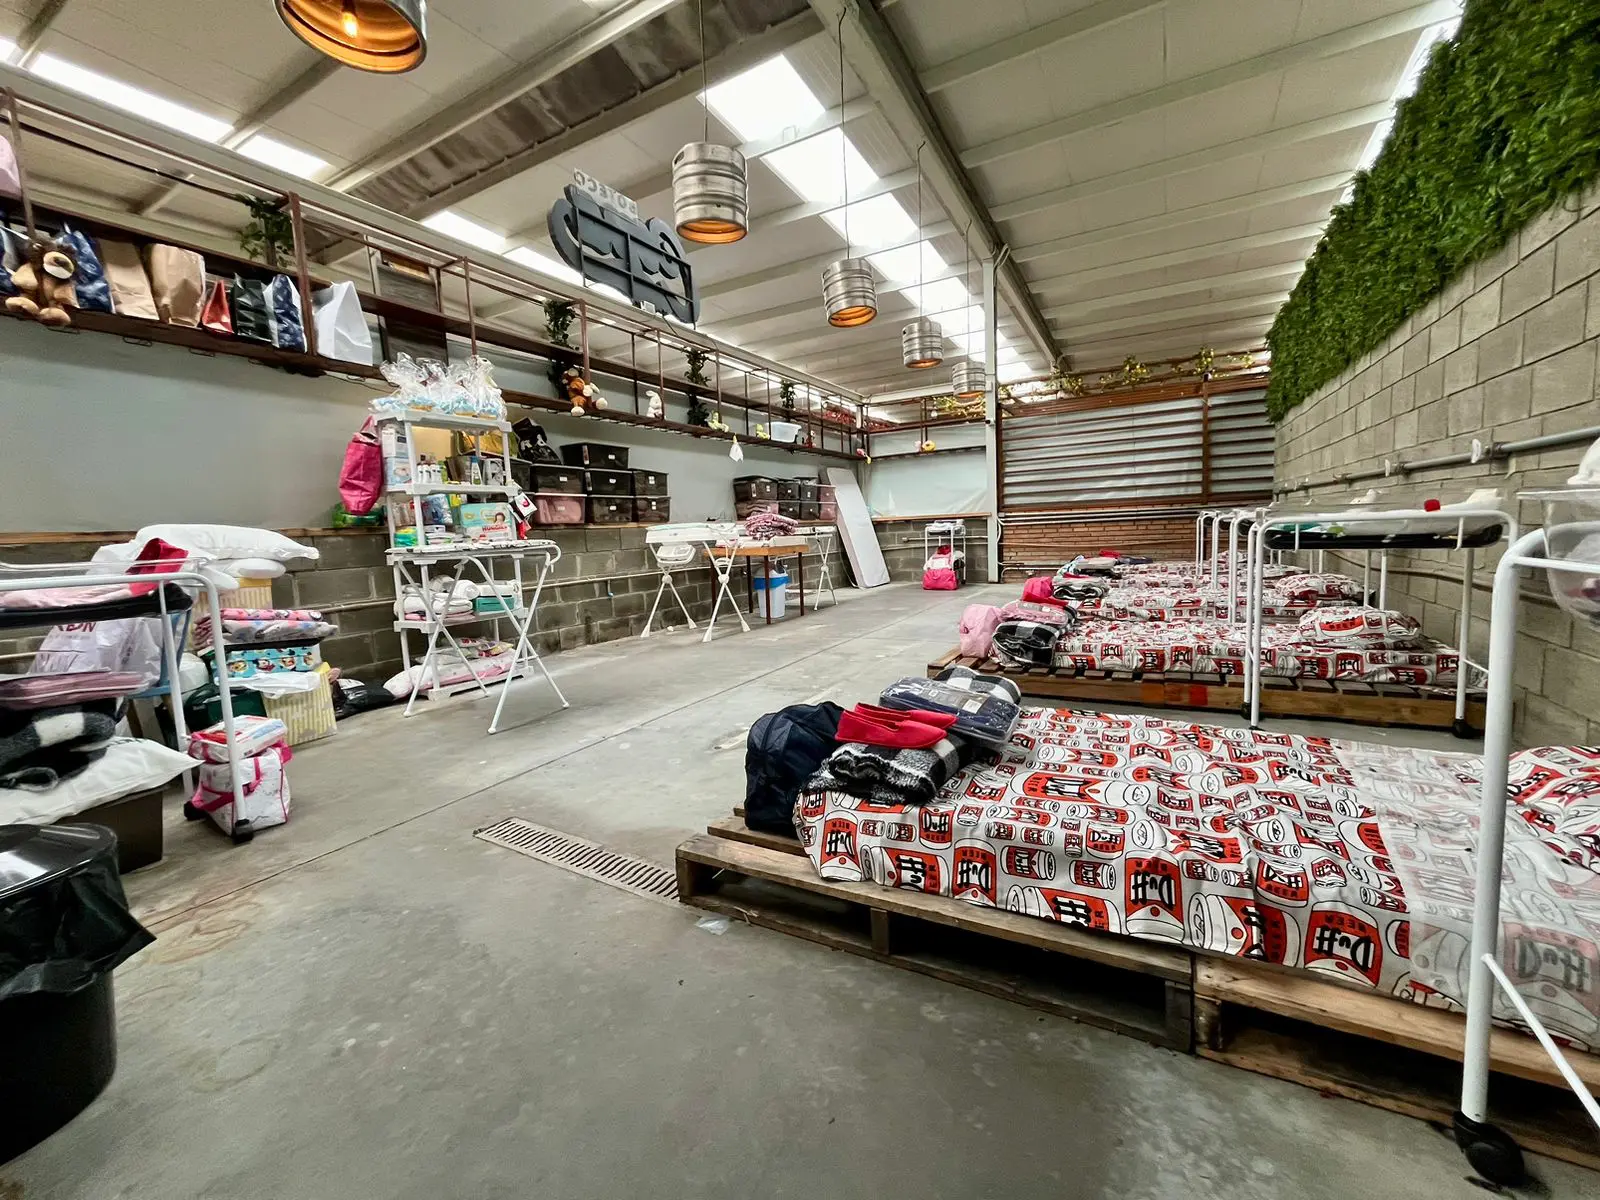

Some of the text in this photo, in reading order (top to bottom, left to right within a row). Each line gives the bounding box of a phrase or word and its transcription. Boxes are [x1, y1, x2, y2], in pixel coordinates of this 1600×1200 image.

[922, 811, 950, 834] Duff
[825, 830, 855, 856] Duff
[957, 860, 991, 892] Duff
[1131, 870, 1175, 911] Duff
[1312, 925, 1375, 972] Duff
